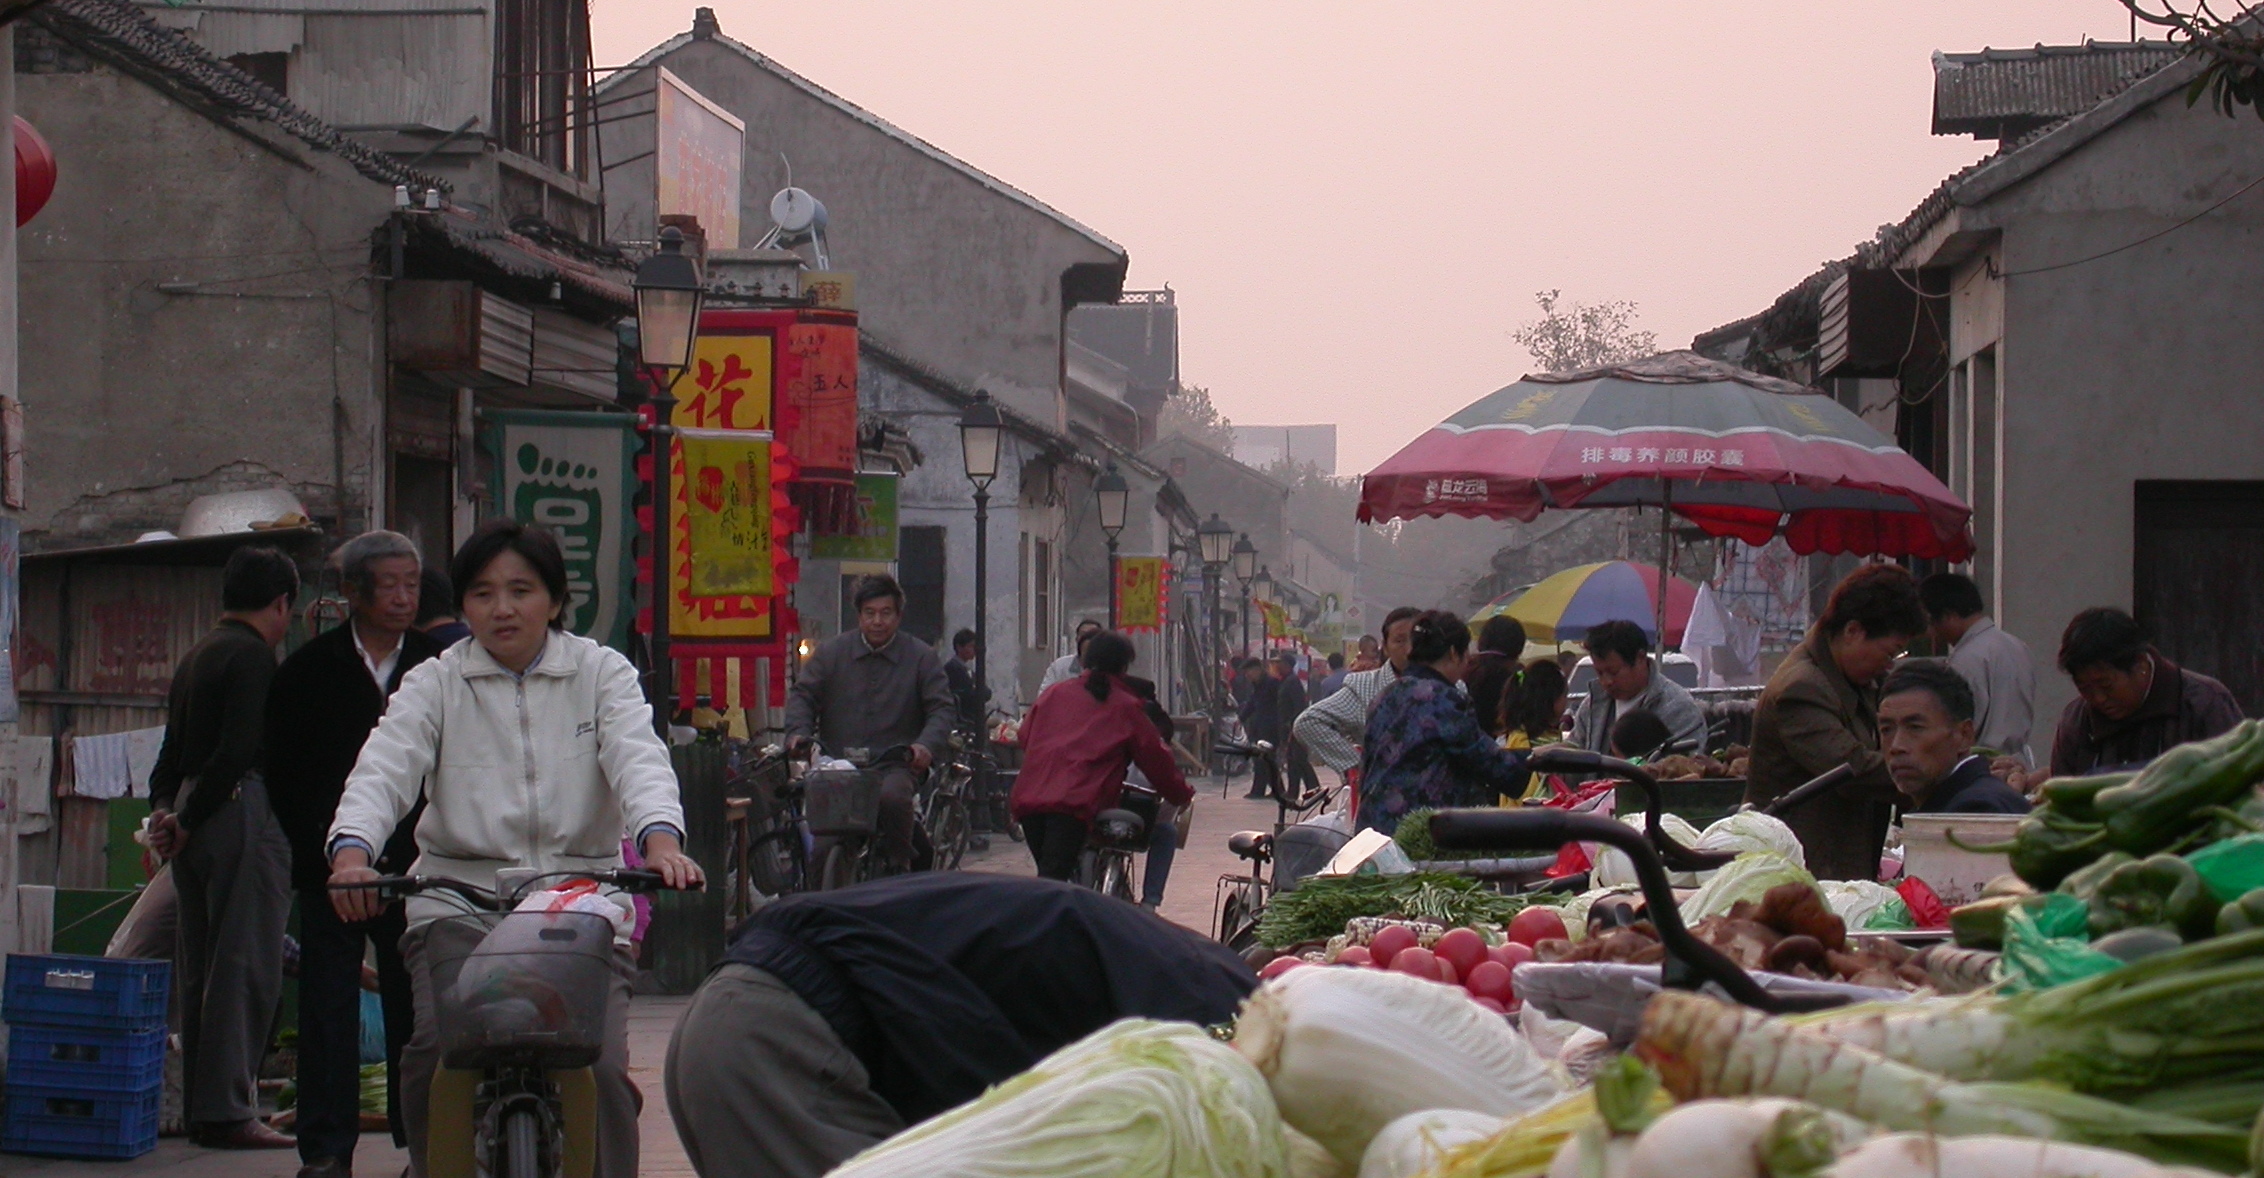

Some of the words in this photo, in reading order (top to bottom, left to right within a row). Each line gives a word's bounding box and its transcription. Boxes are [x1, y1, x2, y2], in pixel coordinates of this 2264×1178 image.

[683, 353, 764, 431] 花
[1581, 447, 1744, 466] 排毒养颜胶囊
